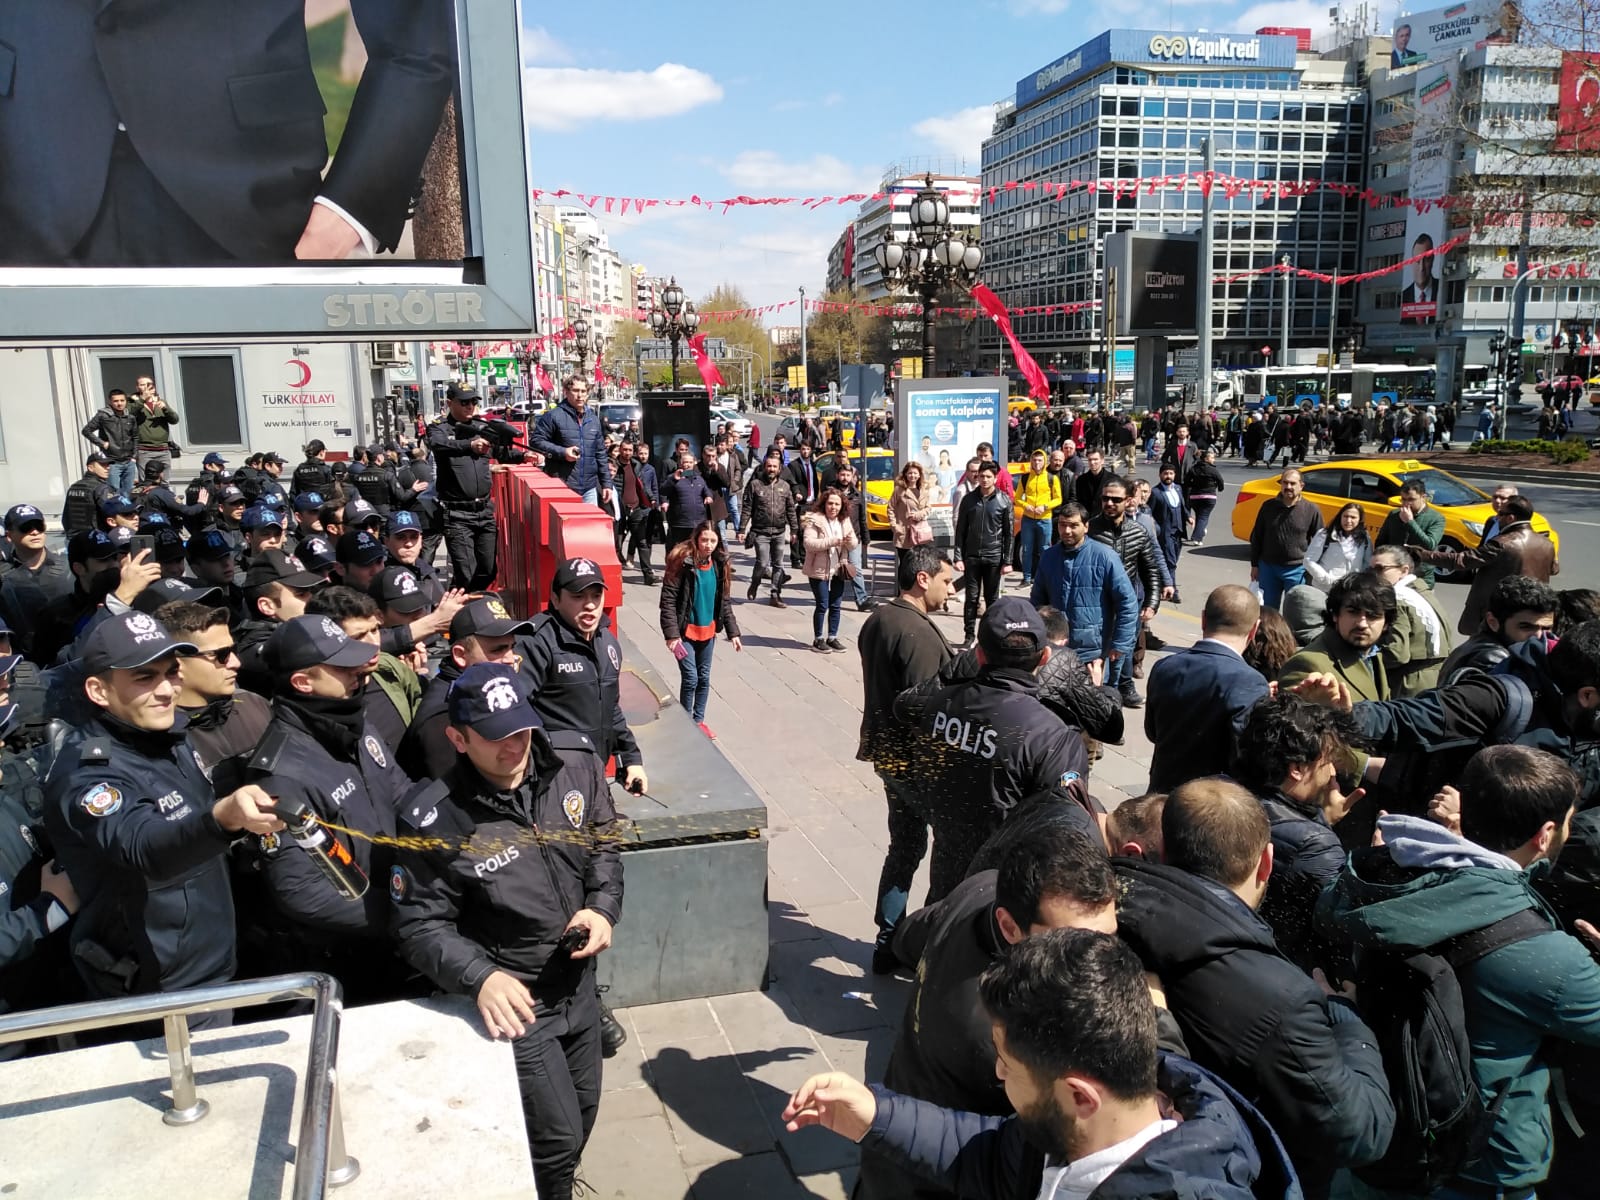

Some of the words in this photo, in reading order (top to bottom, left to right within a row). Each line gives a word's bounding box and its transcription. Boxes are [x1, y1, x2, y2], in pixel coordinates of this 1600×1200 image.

[1187, 36, 1260, 61] YapıKredi
[1503, 261, 1592, 278] SYSAL
[323, 290, 486, 328] STRÖER
[915, 407, 948, 417] sonra
[950, 405, 994, 418] kalplere
[264, 418, 339, 429] www.kanver.org
